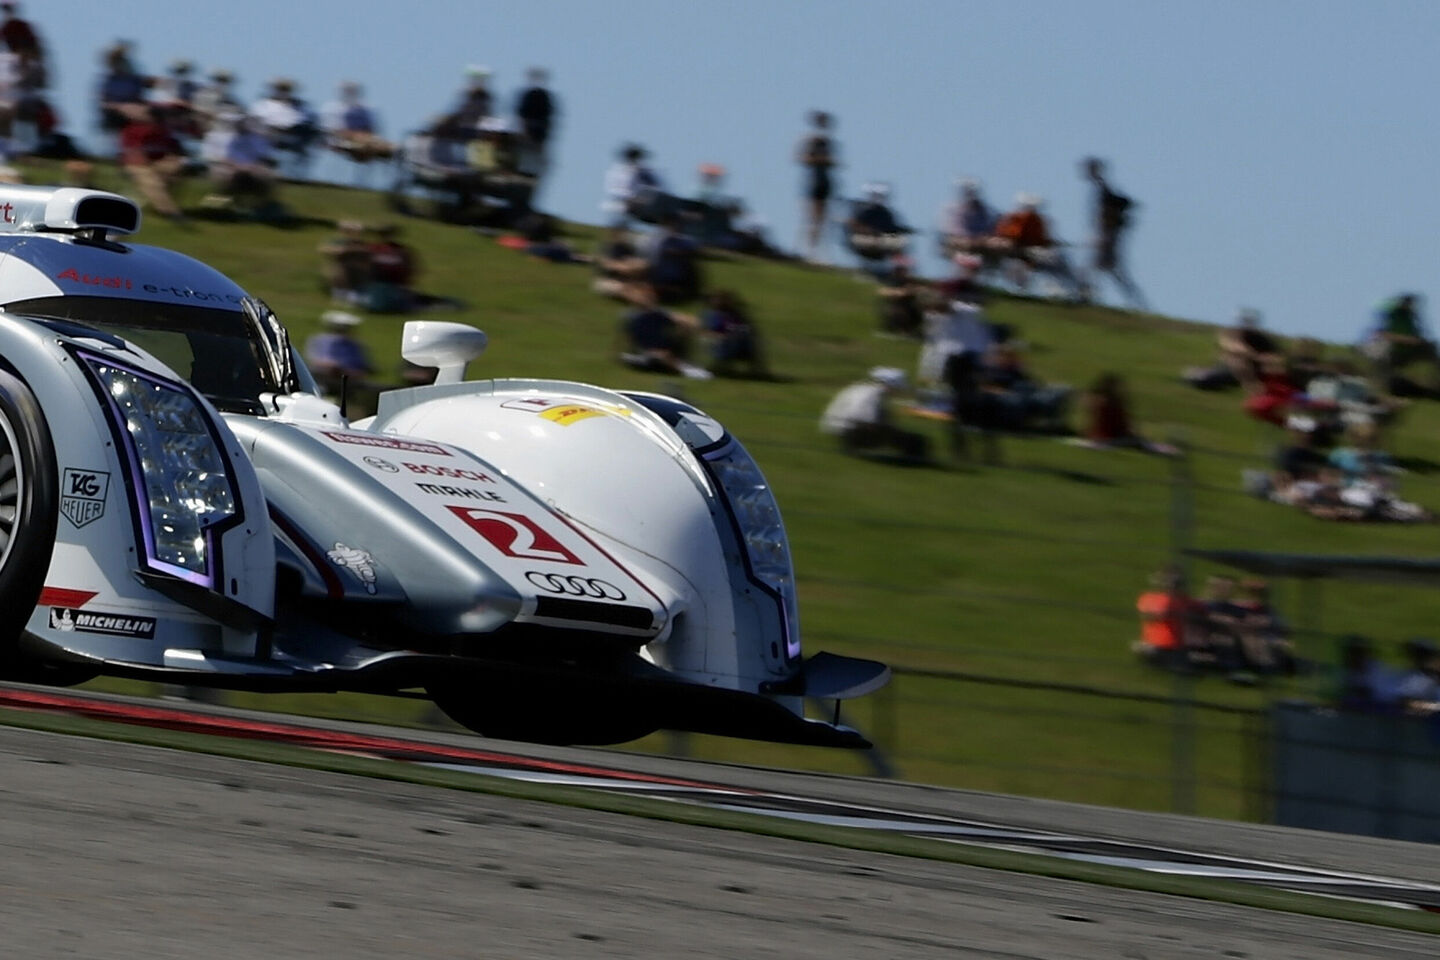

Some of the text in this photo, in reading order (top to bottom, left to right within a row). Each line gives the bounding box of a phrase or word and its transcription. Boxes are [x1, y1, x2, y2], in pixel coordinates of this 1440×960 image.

[57, 267, 133, 290] Audi
[401, 461, 497, 484] BOSCH
[70, 473, 100, 497] TAG
[415, 482, 508, 503] MAHLE
[63, 499, 102, 524] HEUER
[466, 509, 571, 563] 2
[76, 613, 153, 633] MICHELIN
